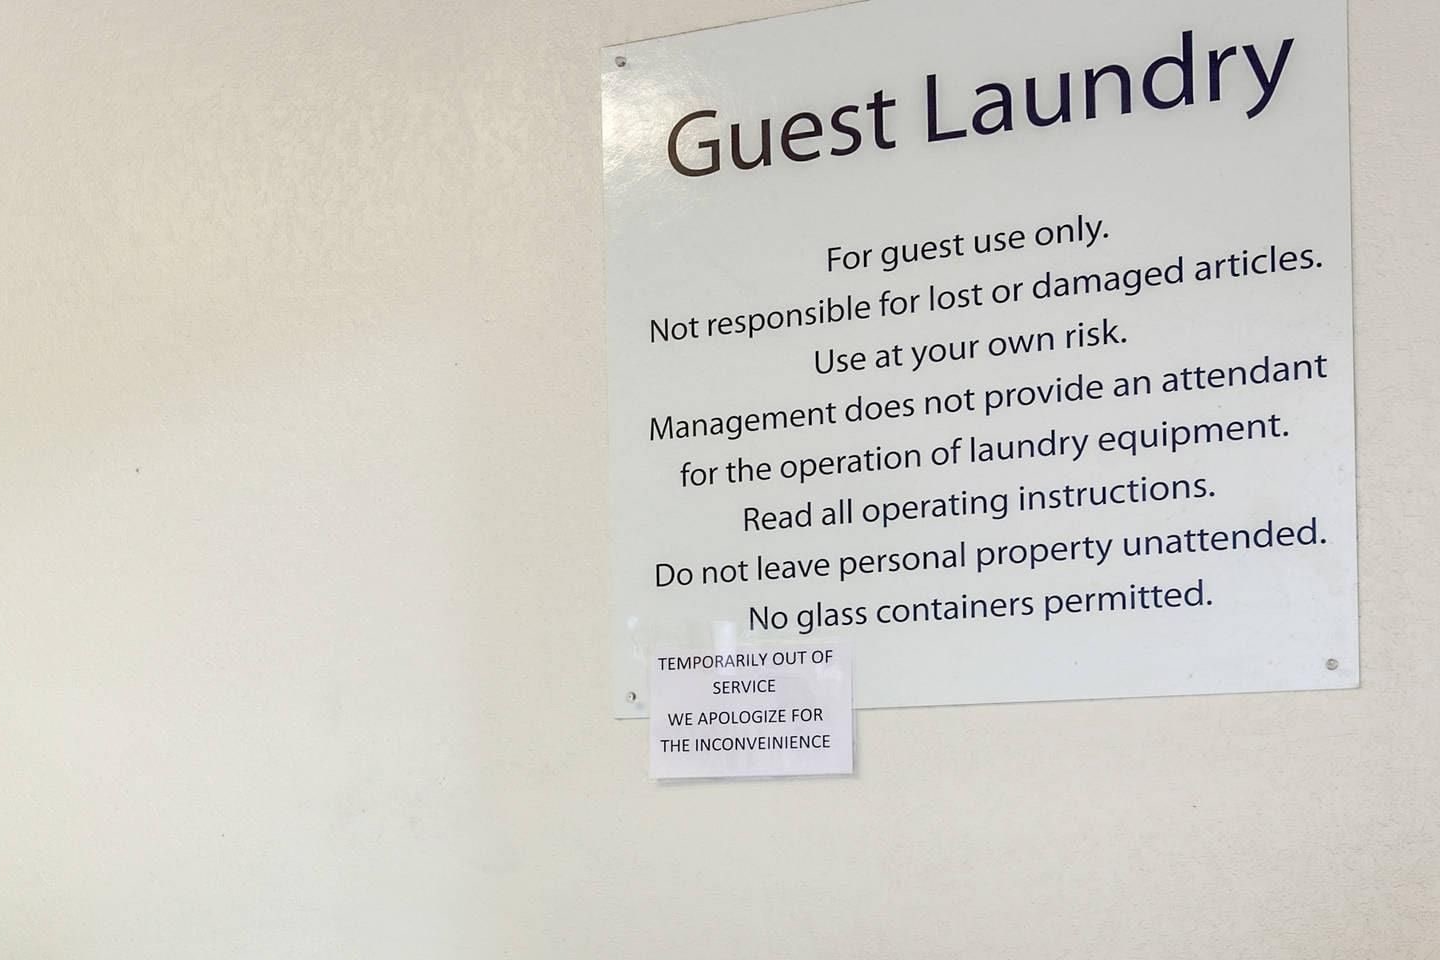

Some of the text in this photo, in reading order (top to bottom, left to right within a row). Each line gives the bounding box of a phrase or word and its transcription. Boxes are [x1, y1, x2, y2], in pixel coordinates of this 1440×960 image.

[667, 29, 1295, 178] Guest Laundry
[827, 214, 1109, 273] For guest use only.
[650, 244, 1323, 344] Not responsible for lost or damaged articles.
[815, 317, 1127, 375] Use at your own risk.
[650, 354, 1328, 441] Management does not provide an attendant
[679, 414, 1289, 488] for the operation of laundry equipment.
[744, 476, 1215, 532] Read all operating instructions.
[655, 516, 1327, 588] Do not leave personal property unattended.
[749, 578, 1213, 635] No glass containers permitted.
[657, 649, 833, 671] TEMPORARILY OUT OF
[712, 679, 776, 695] SERVICE
[660, 734, 831, 753] THE INCONVEINIENCE
[667, 707, 824, 726] WE APOLOGIZE FOR
